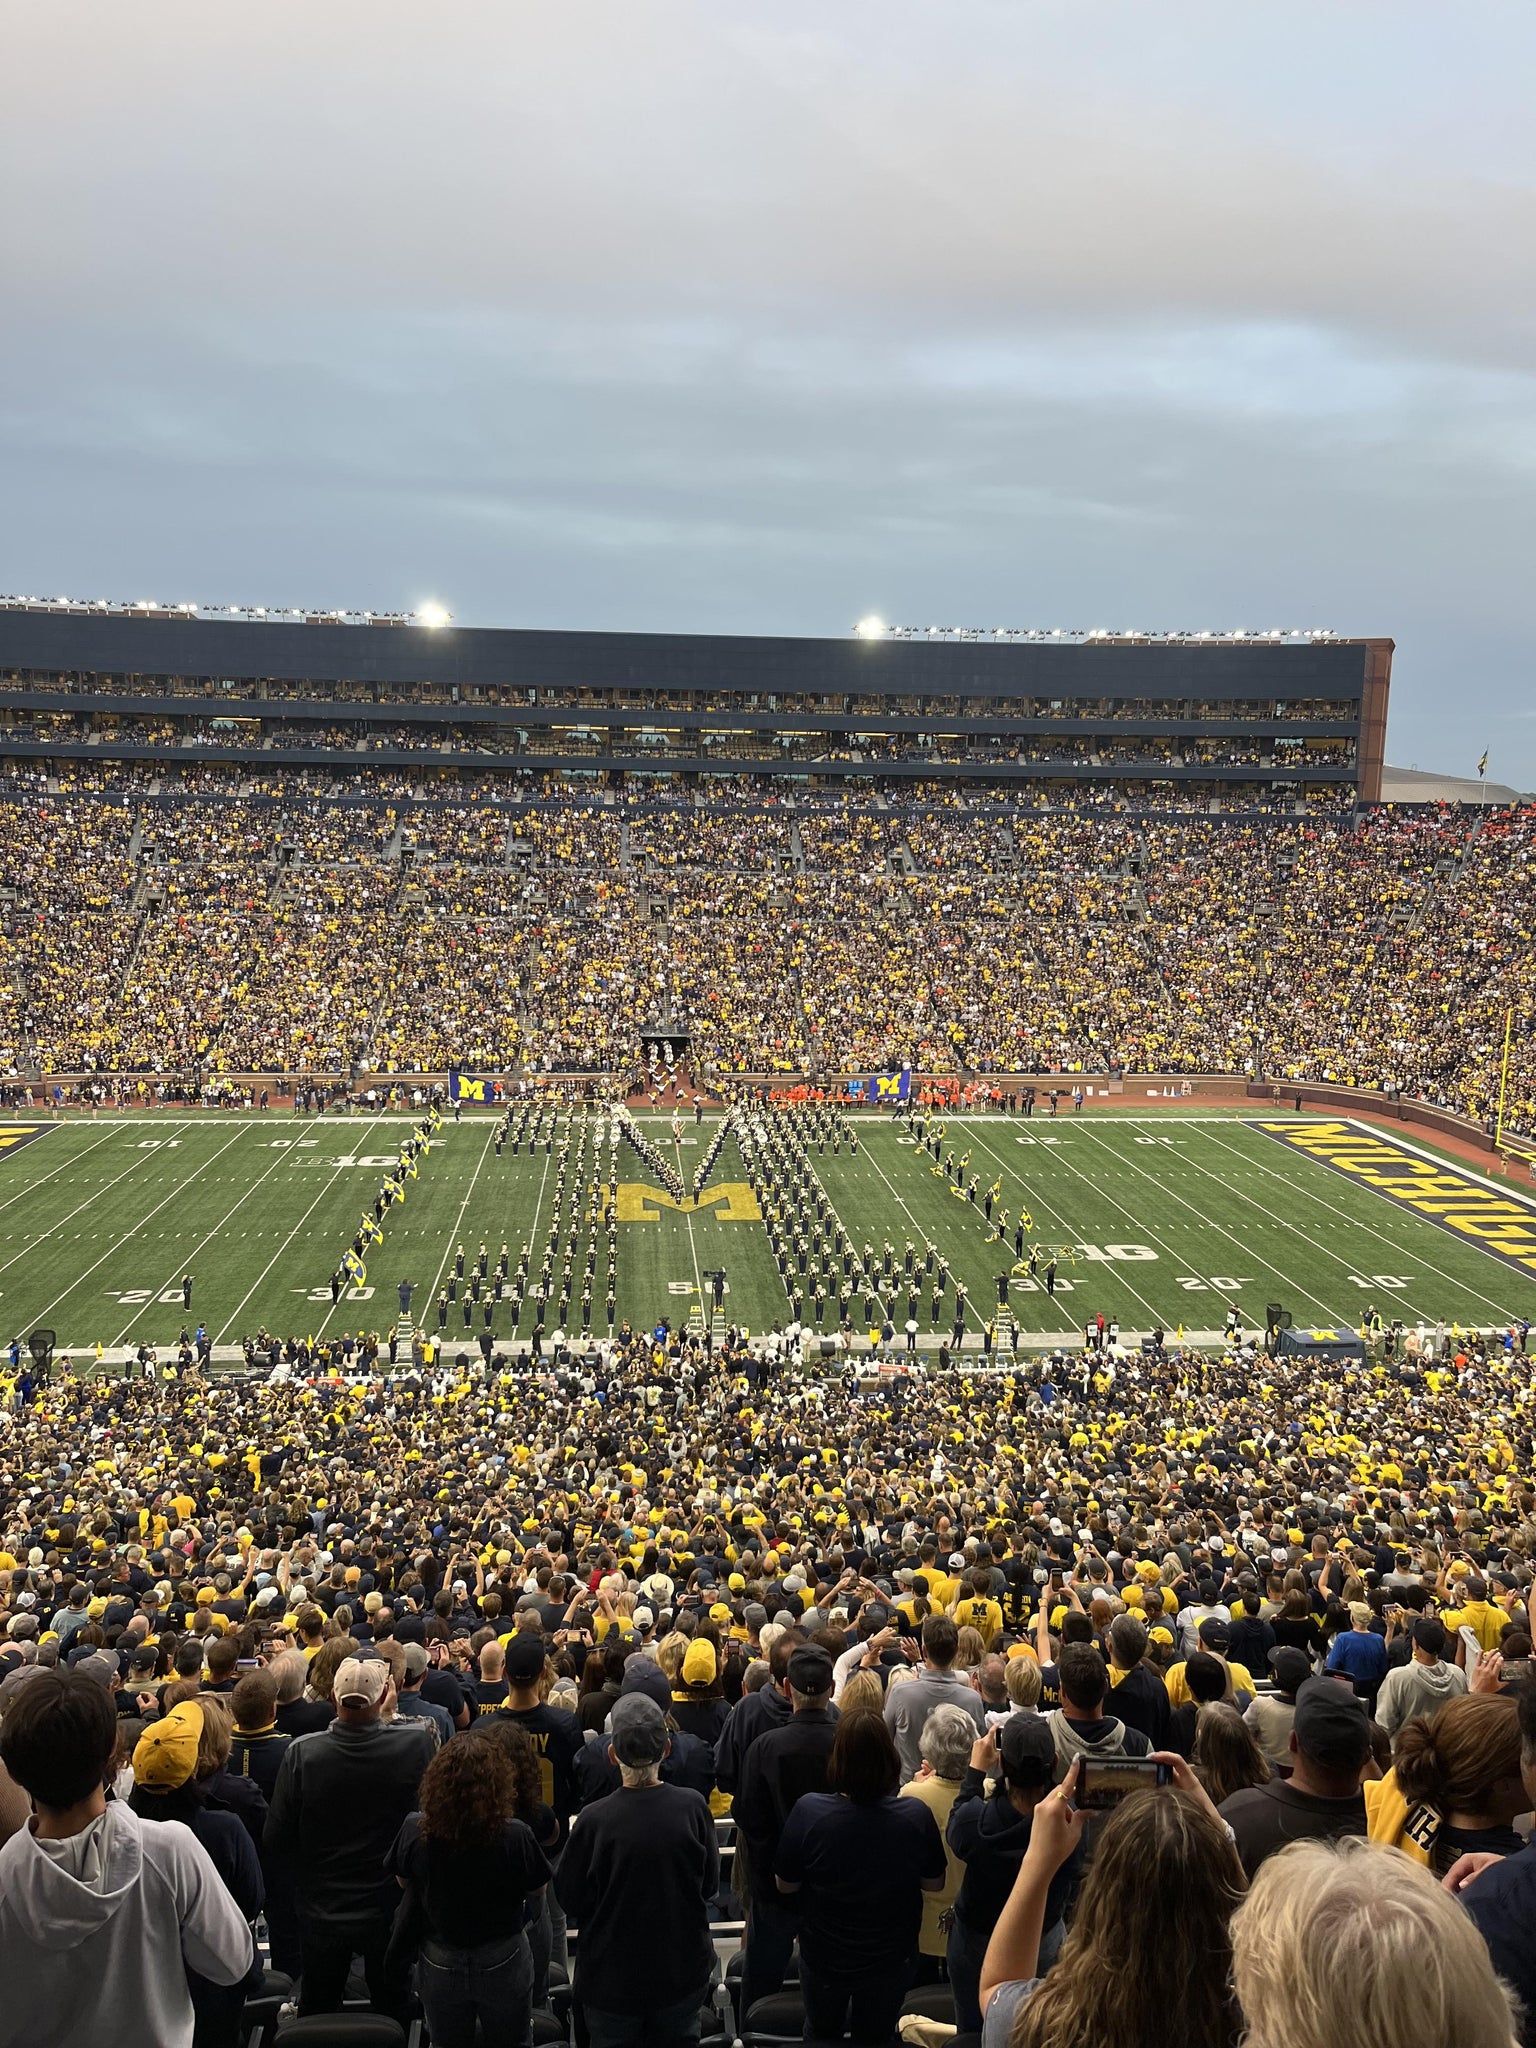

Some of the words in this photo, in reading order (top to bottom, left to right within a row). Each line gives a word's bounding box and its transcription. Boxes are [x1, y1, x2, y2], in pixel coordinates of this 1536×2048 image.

[458, 1075, 485, 1101] M
[877, 1073, 902, 1097] M
[584, 1182, 783, 1221] M
[1009, 1278, 1076, 1292] 30
[1175, 1277, 1244, 1290] 20
[1347, 1275, 1408, 1288] 10
[116, 1289, 186, 1304] 20
[307, 1286, 376, 1301] 30
[972, 1603, 987, 1615] M
